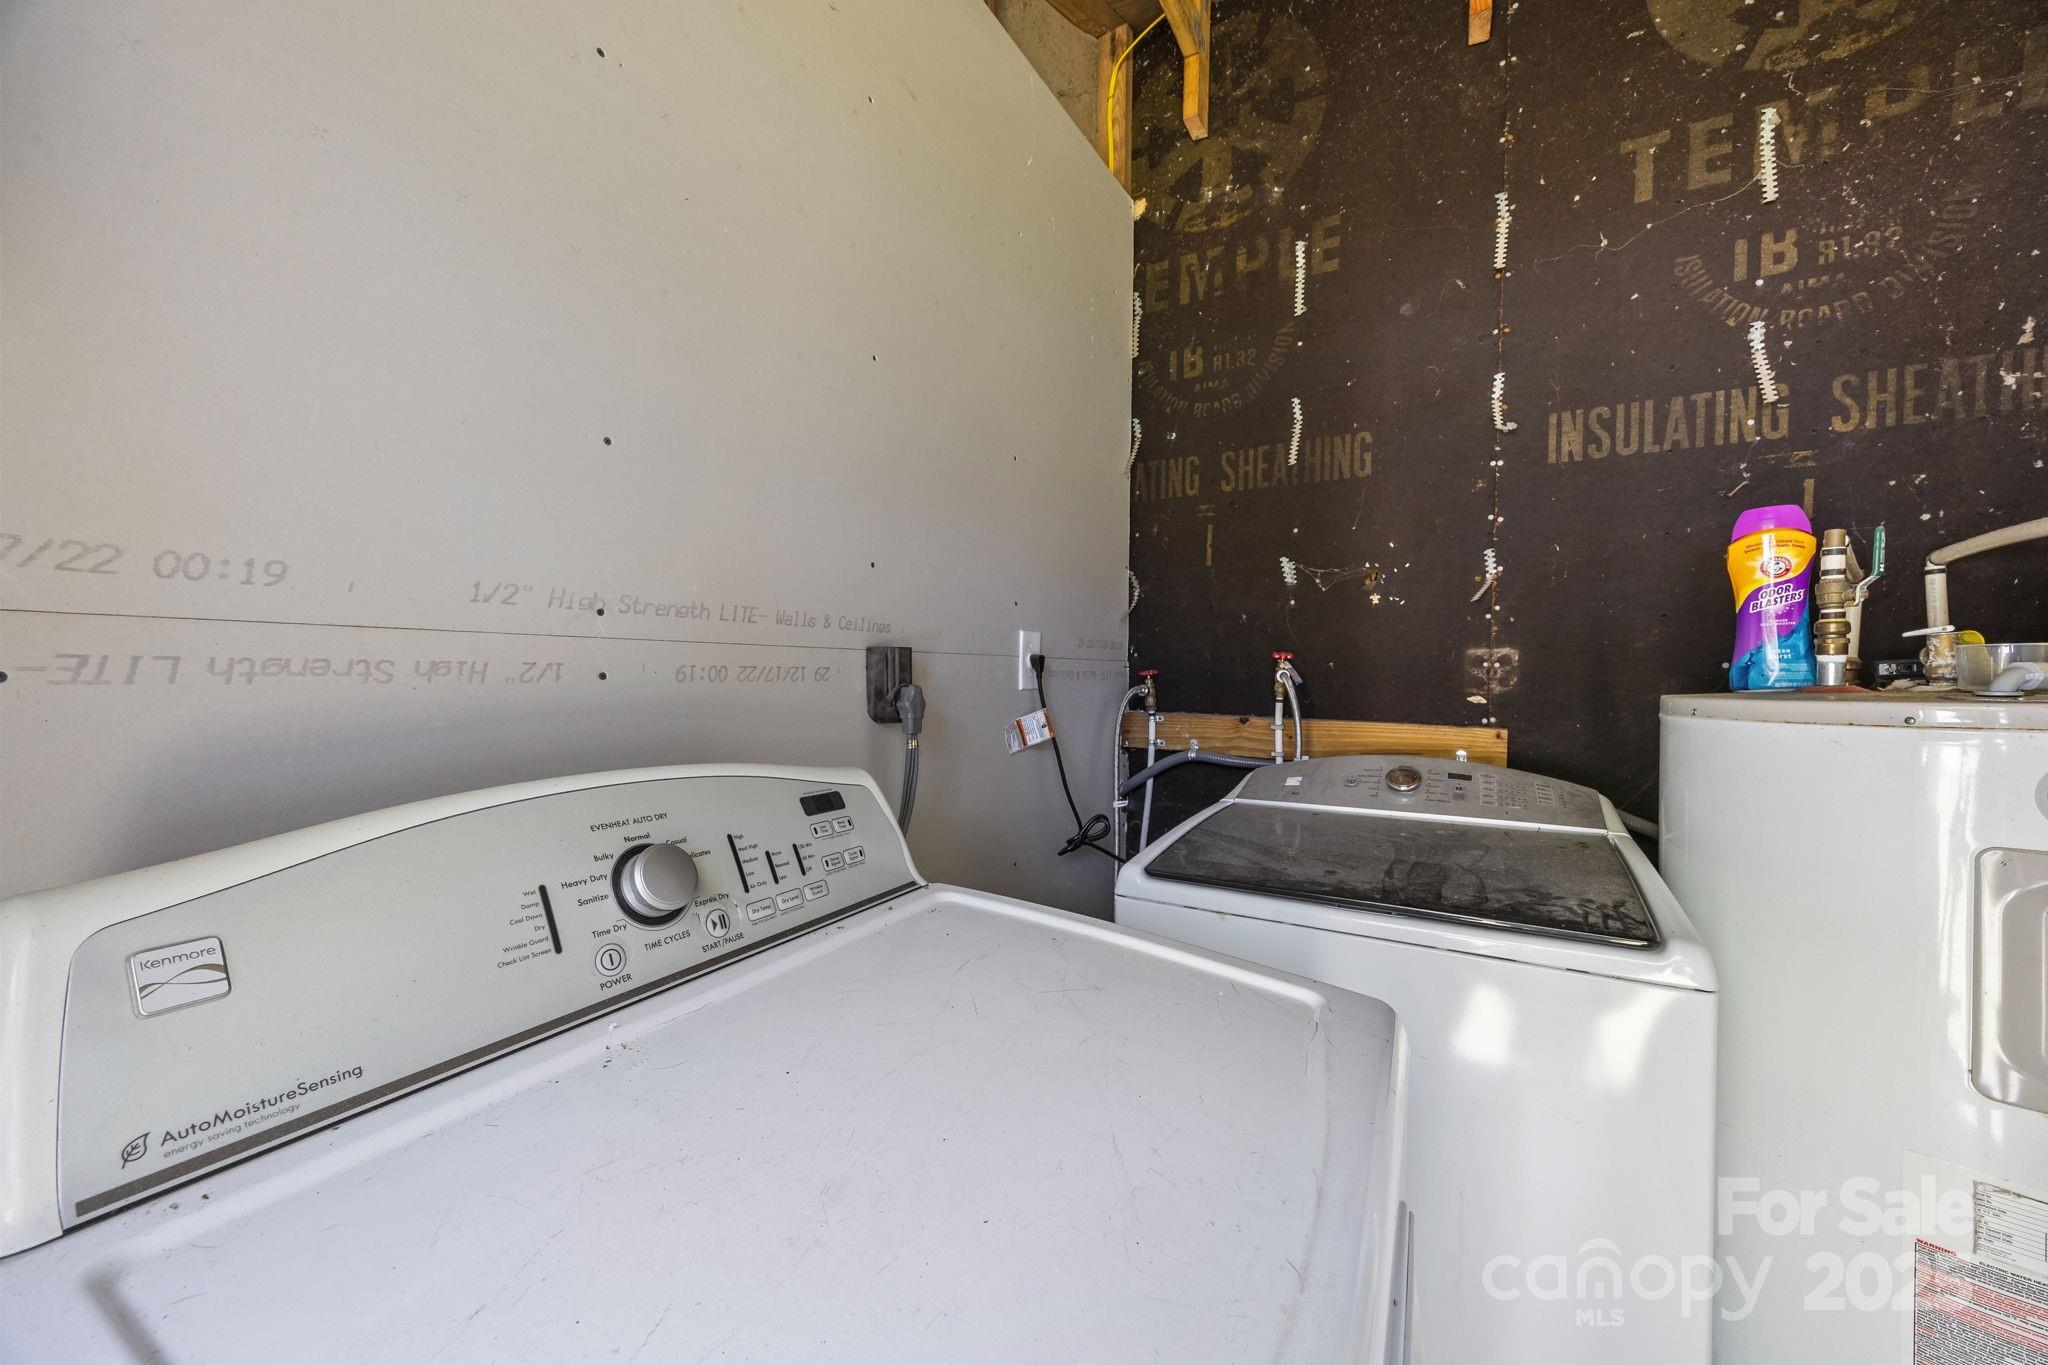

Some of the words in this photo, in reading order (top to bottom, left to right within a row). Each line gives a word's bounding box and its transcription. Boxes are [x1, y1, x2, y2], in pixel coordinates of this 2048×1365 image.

[1547, 382, 1790, 463] INSULATING
[1220, 431, 1373, 493] SHEATHING
[0, 534, 122, 575] 7/22
[153, 549, 289, 586] 00:19
[1751, 591, 1803, 611] BLASTERS
[1760, 584, 1792, 600] ODOR
[548, 586, 606, 612] High
[618, 594, 711, 620] Strength
[776, 610, 816, 629] Walls
[823, 615, 832, 629] &
[838, 615, 891, 633] Ceilings
[207, 656, 394, 684] Strength
[414, 659, 488, 684] High
[676, 664, 728, 682] 00:19
[590, 819, 630, 832] EVENHEAT
[633, 816, 651, 825] AUTO
[652, 812, 667, 822] DRY
[624, 832, 650, 843] Normal
[665, 837, 687, 846] Casual
[594, 852, 614, 863] Bulky
[561, 878, 587, 890] Heavy
[590, 873, 608, 885] Duty
[523, 889, 536, 897] Wet
[577, 893, 609, 907] Sanitize
[694, 895, 717, 908] Express
[717, 892, 729, 902] Dry
[521, 901, 540, 911] Damp
[509, 916, 525, 926] Cool
[526, 912, 543, 921] Down
[534, 924, 546, 933] Dry
[592, 928, 611, 939] Time
[613, 922, 627, 934] Dry
[502, 941, 528, 953] Wrinkle
[529, 936, 549, 946] Guard
[644, 939, 662, 951] TIME
[664, 930, 691, 945] CYCLES
[702, 932, 744, 953] START/PAUSE
[139, 945, 216, 971] Kenmore
[497, 957, 517, 969] Check
[518, 954, 529, 963] Lint
[530, 948, 552, 959] Screen
[600, 972, 632, 990] POWER
[160, 1065, 363, 1146] AutoMoistureSensing
[163, 1140, 204, 1159] energy
[207, 1124, 242, 1144] saving
[244, 1103, 301, 1129] technology
[1915, 1237, 1957, 1256] WARNING
[1979, 1261, 2009, 1275] ELECTRIC
[2010, 1271, 2032, 1283] WATER
